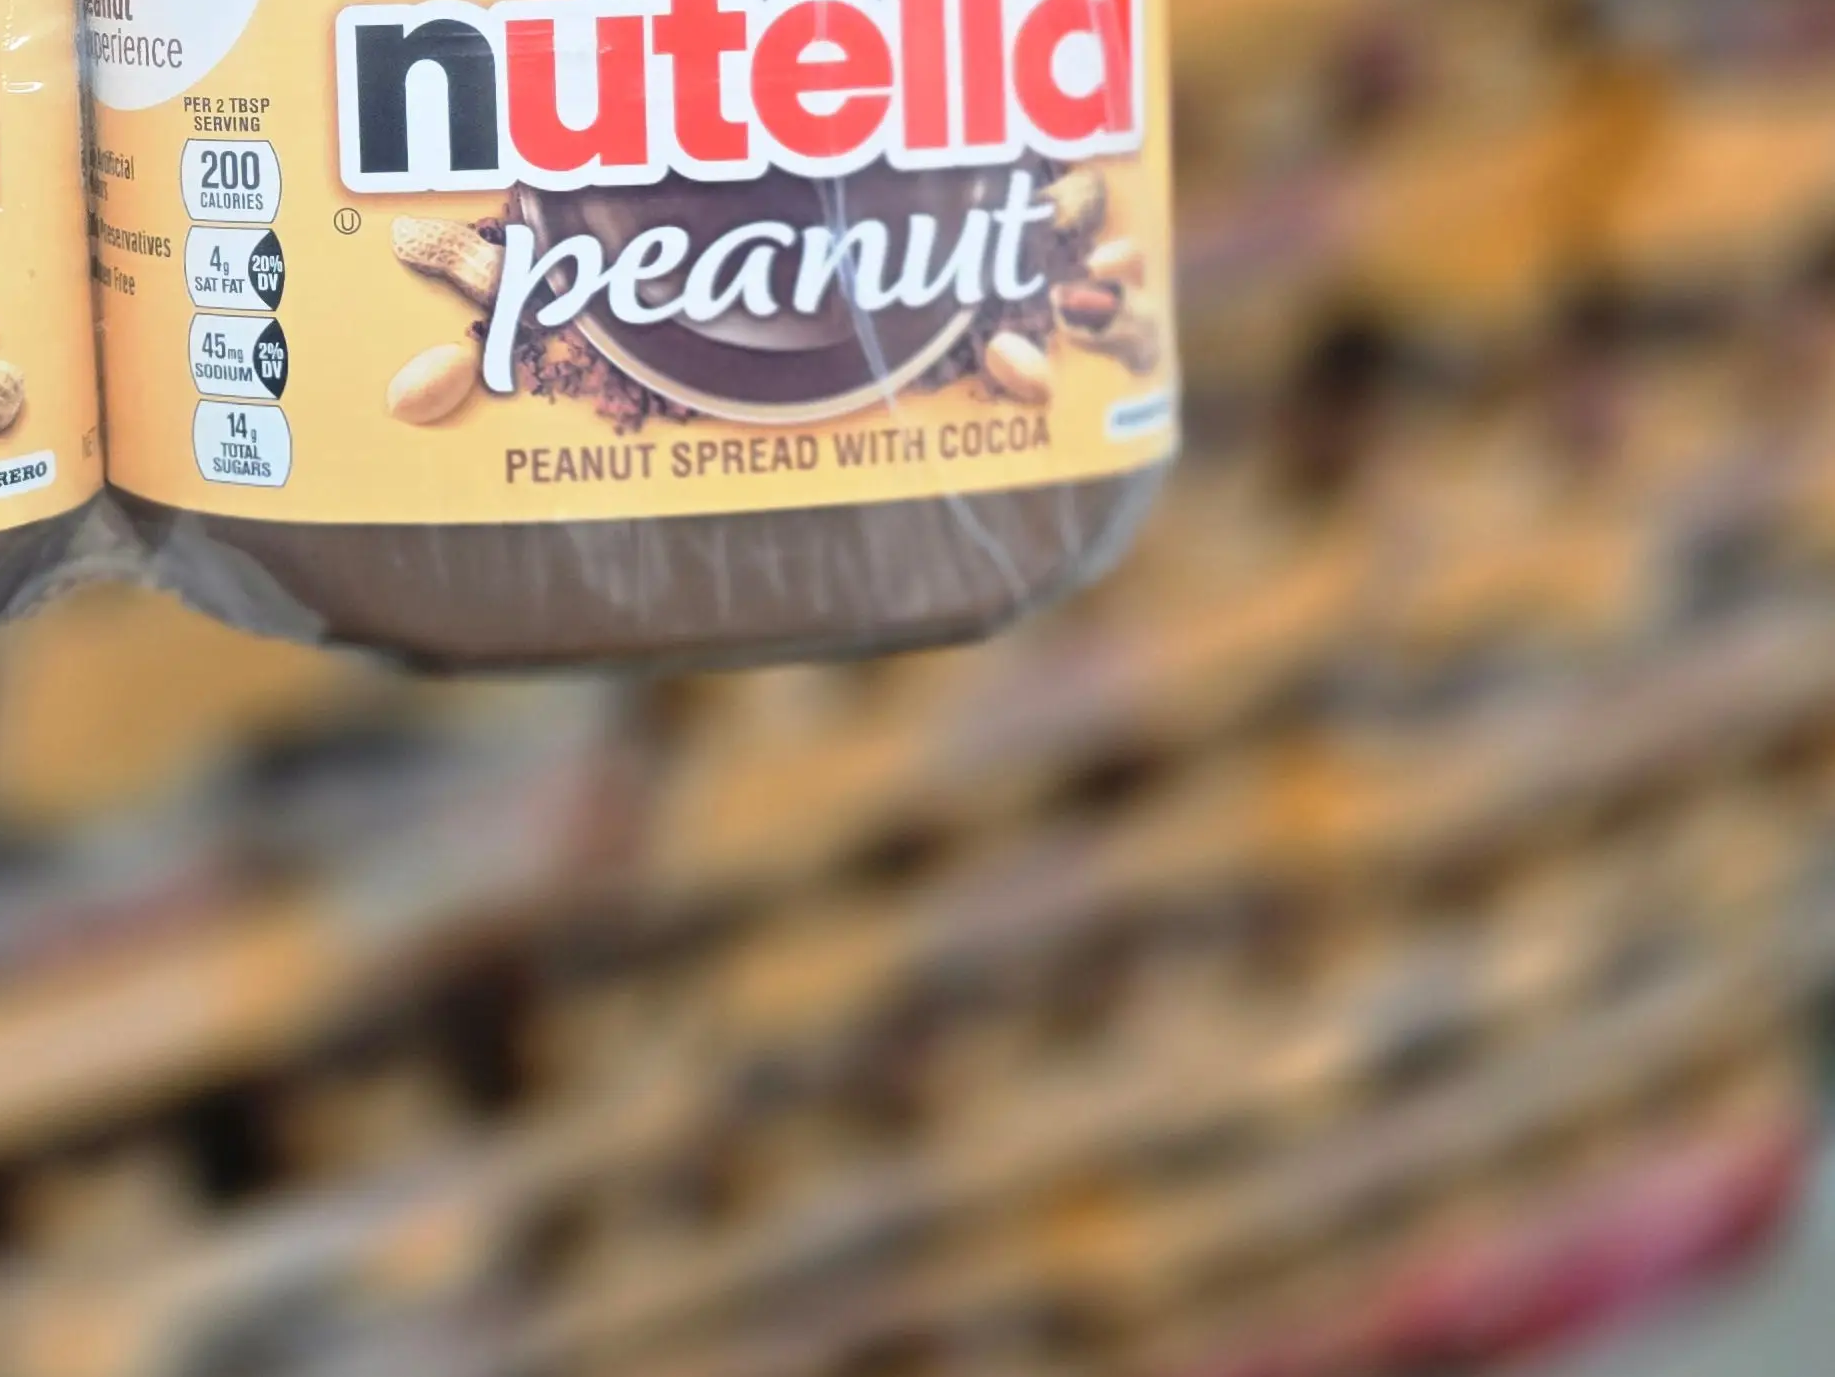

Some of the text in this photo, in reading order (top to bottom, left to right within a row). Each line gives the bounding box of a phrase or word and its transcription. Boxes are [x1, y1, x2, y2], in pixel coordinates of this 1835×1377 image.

[86, 28, 183, 68] perience
[183, 97, 270, 114] PER 2 TBSP
[194, 116, 261, 132] SERVING
[200, 150, 261, 190] 200
[200, 193, 264, 211] CALORIES
[252, 254, 283, 273] 20%
[195, 277, 245, 293] SAT FAT
[258, 273, 279, 292] DV
[482, 169, 1055, 394] peanut
[258, 342, 284, 361] 2%
[195, 362, 253, 383] SODIUM
[261, 361, 283, 380] DV
[220, 442, 261, 461] TOTAL
[505, 415, 1051, 484] PEANUT SPREAD WITH COCOA
[213, 457, 271, 478] SUGARS
